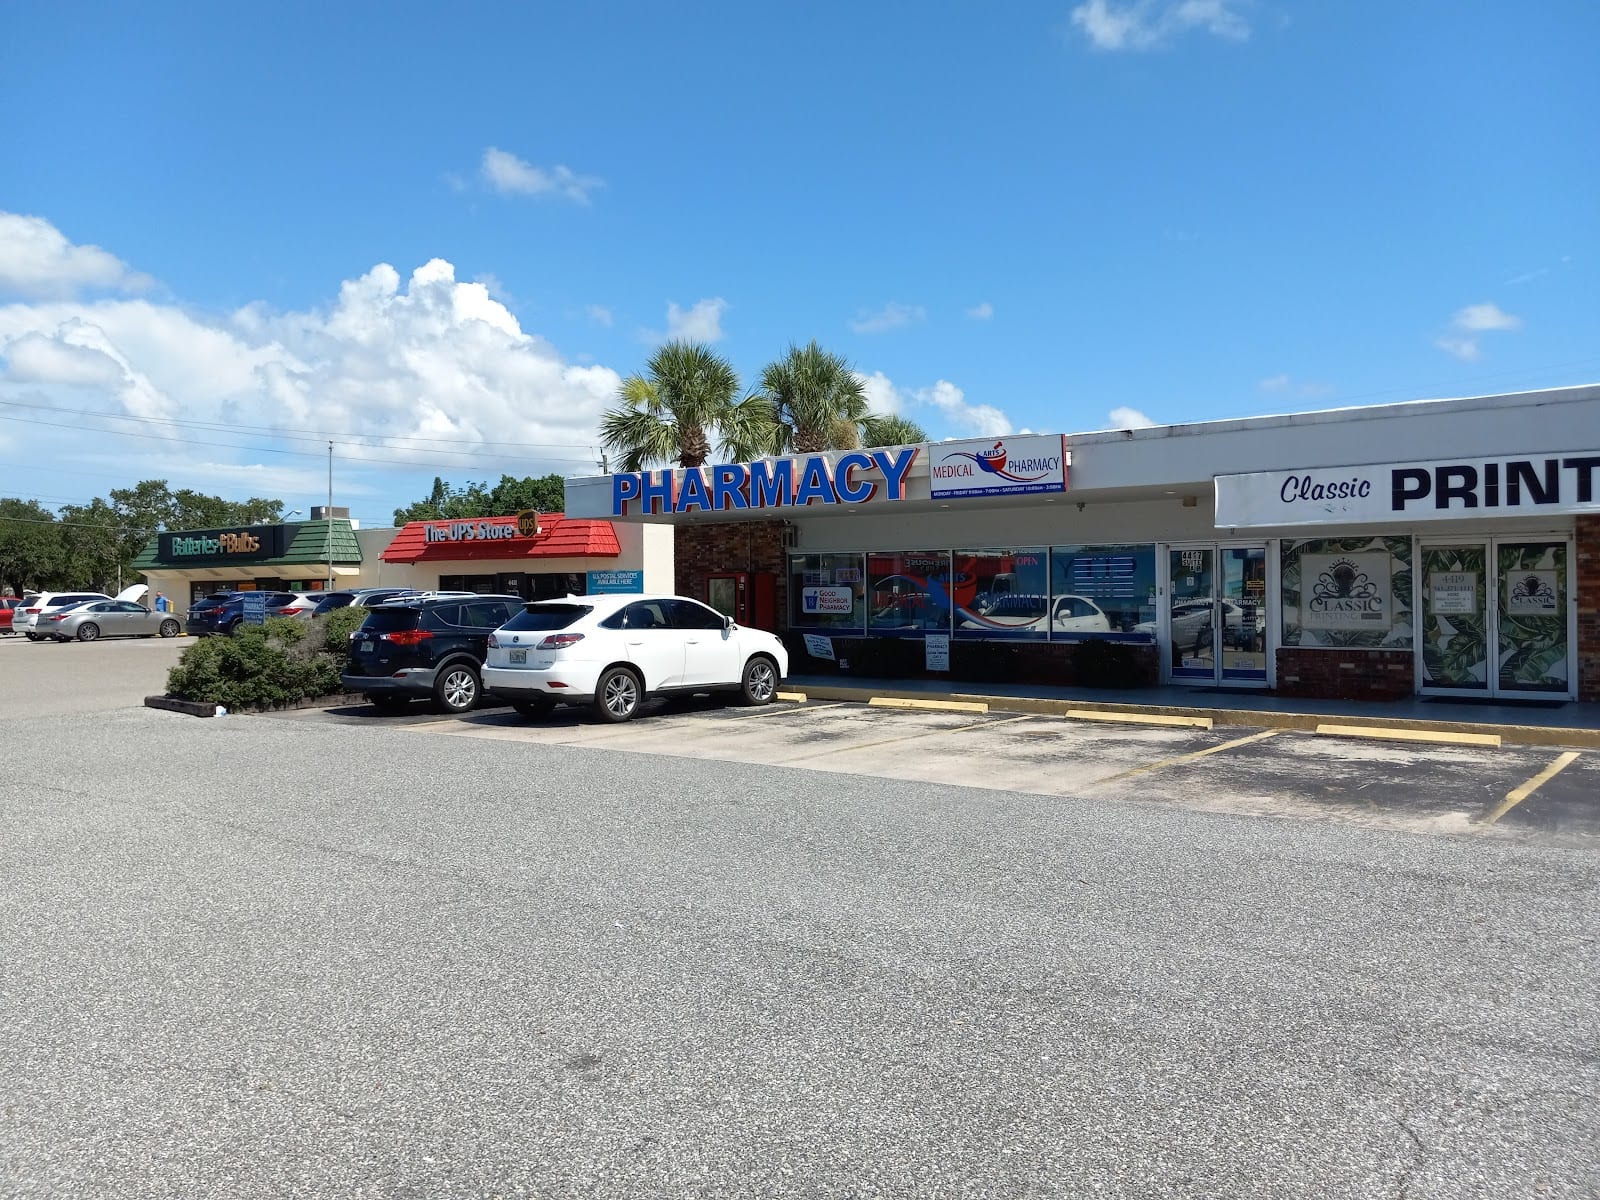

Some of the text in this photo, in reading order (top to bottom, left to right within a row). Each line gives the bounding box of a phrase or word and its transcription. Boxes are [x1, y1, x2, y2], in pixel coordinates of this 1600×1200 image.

[933, 457, 1060, 478] MEDICAL PHARMACY
[612, 448, 918, 517] PHARMACY
[1280, 458, 1600, 511] Classic PRINT
[425, 521, 514, 541] The UPS Store
[519, 518, 534, 534] ups
[172, 536, 218, 556] Batteries
[227, 532, 260, 553] Bulbs
[1017, 556, 1039, 566] OPEN
[1310, 597, 1382, 612] CLASSIC
